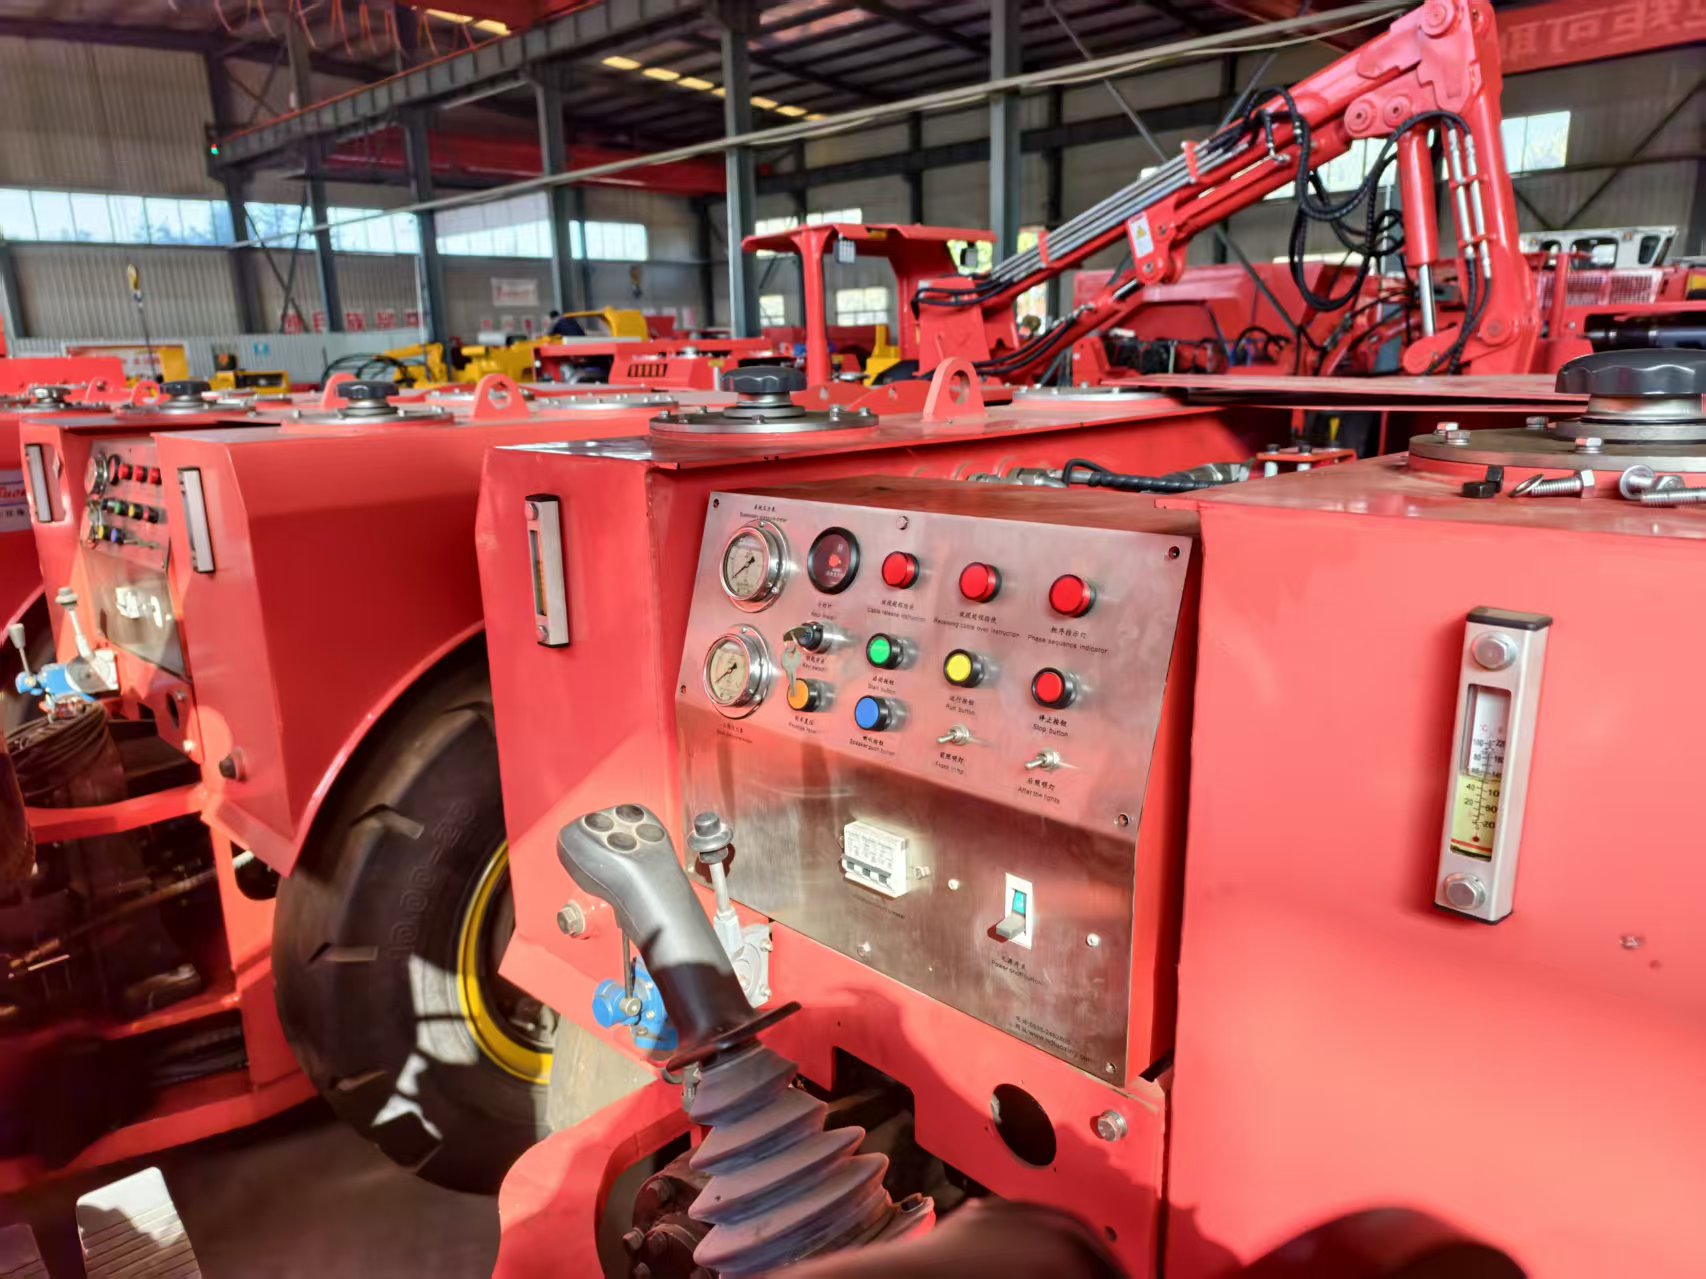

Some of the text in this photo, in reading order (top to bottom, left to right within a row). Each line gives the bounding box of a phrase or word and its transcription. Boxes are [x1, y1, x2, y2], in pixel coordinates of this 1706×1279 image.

[991, 628, 1020, 638] instruction
[1028, 634, 1108, 654] Phase sequence indicator
[958, 706, 975, 715] button
[1033, 724, 1069, 737] Stop button
[1018, 787, 1060, 804] After the lights
